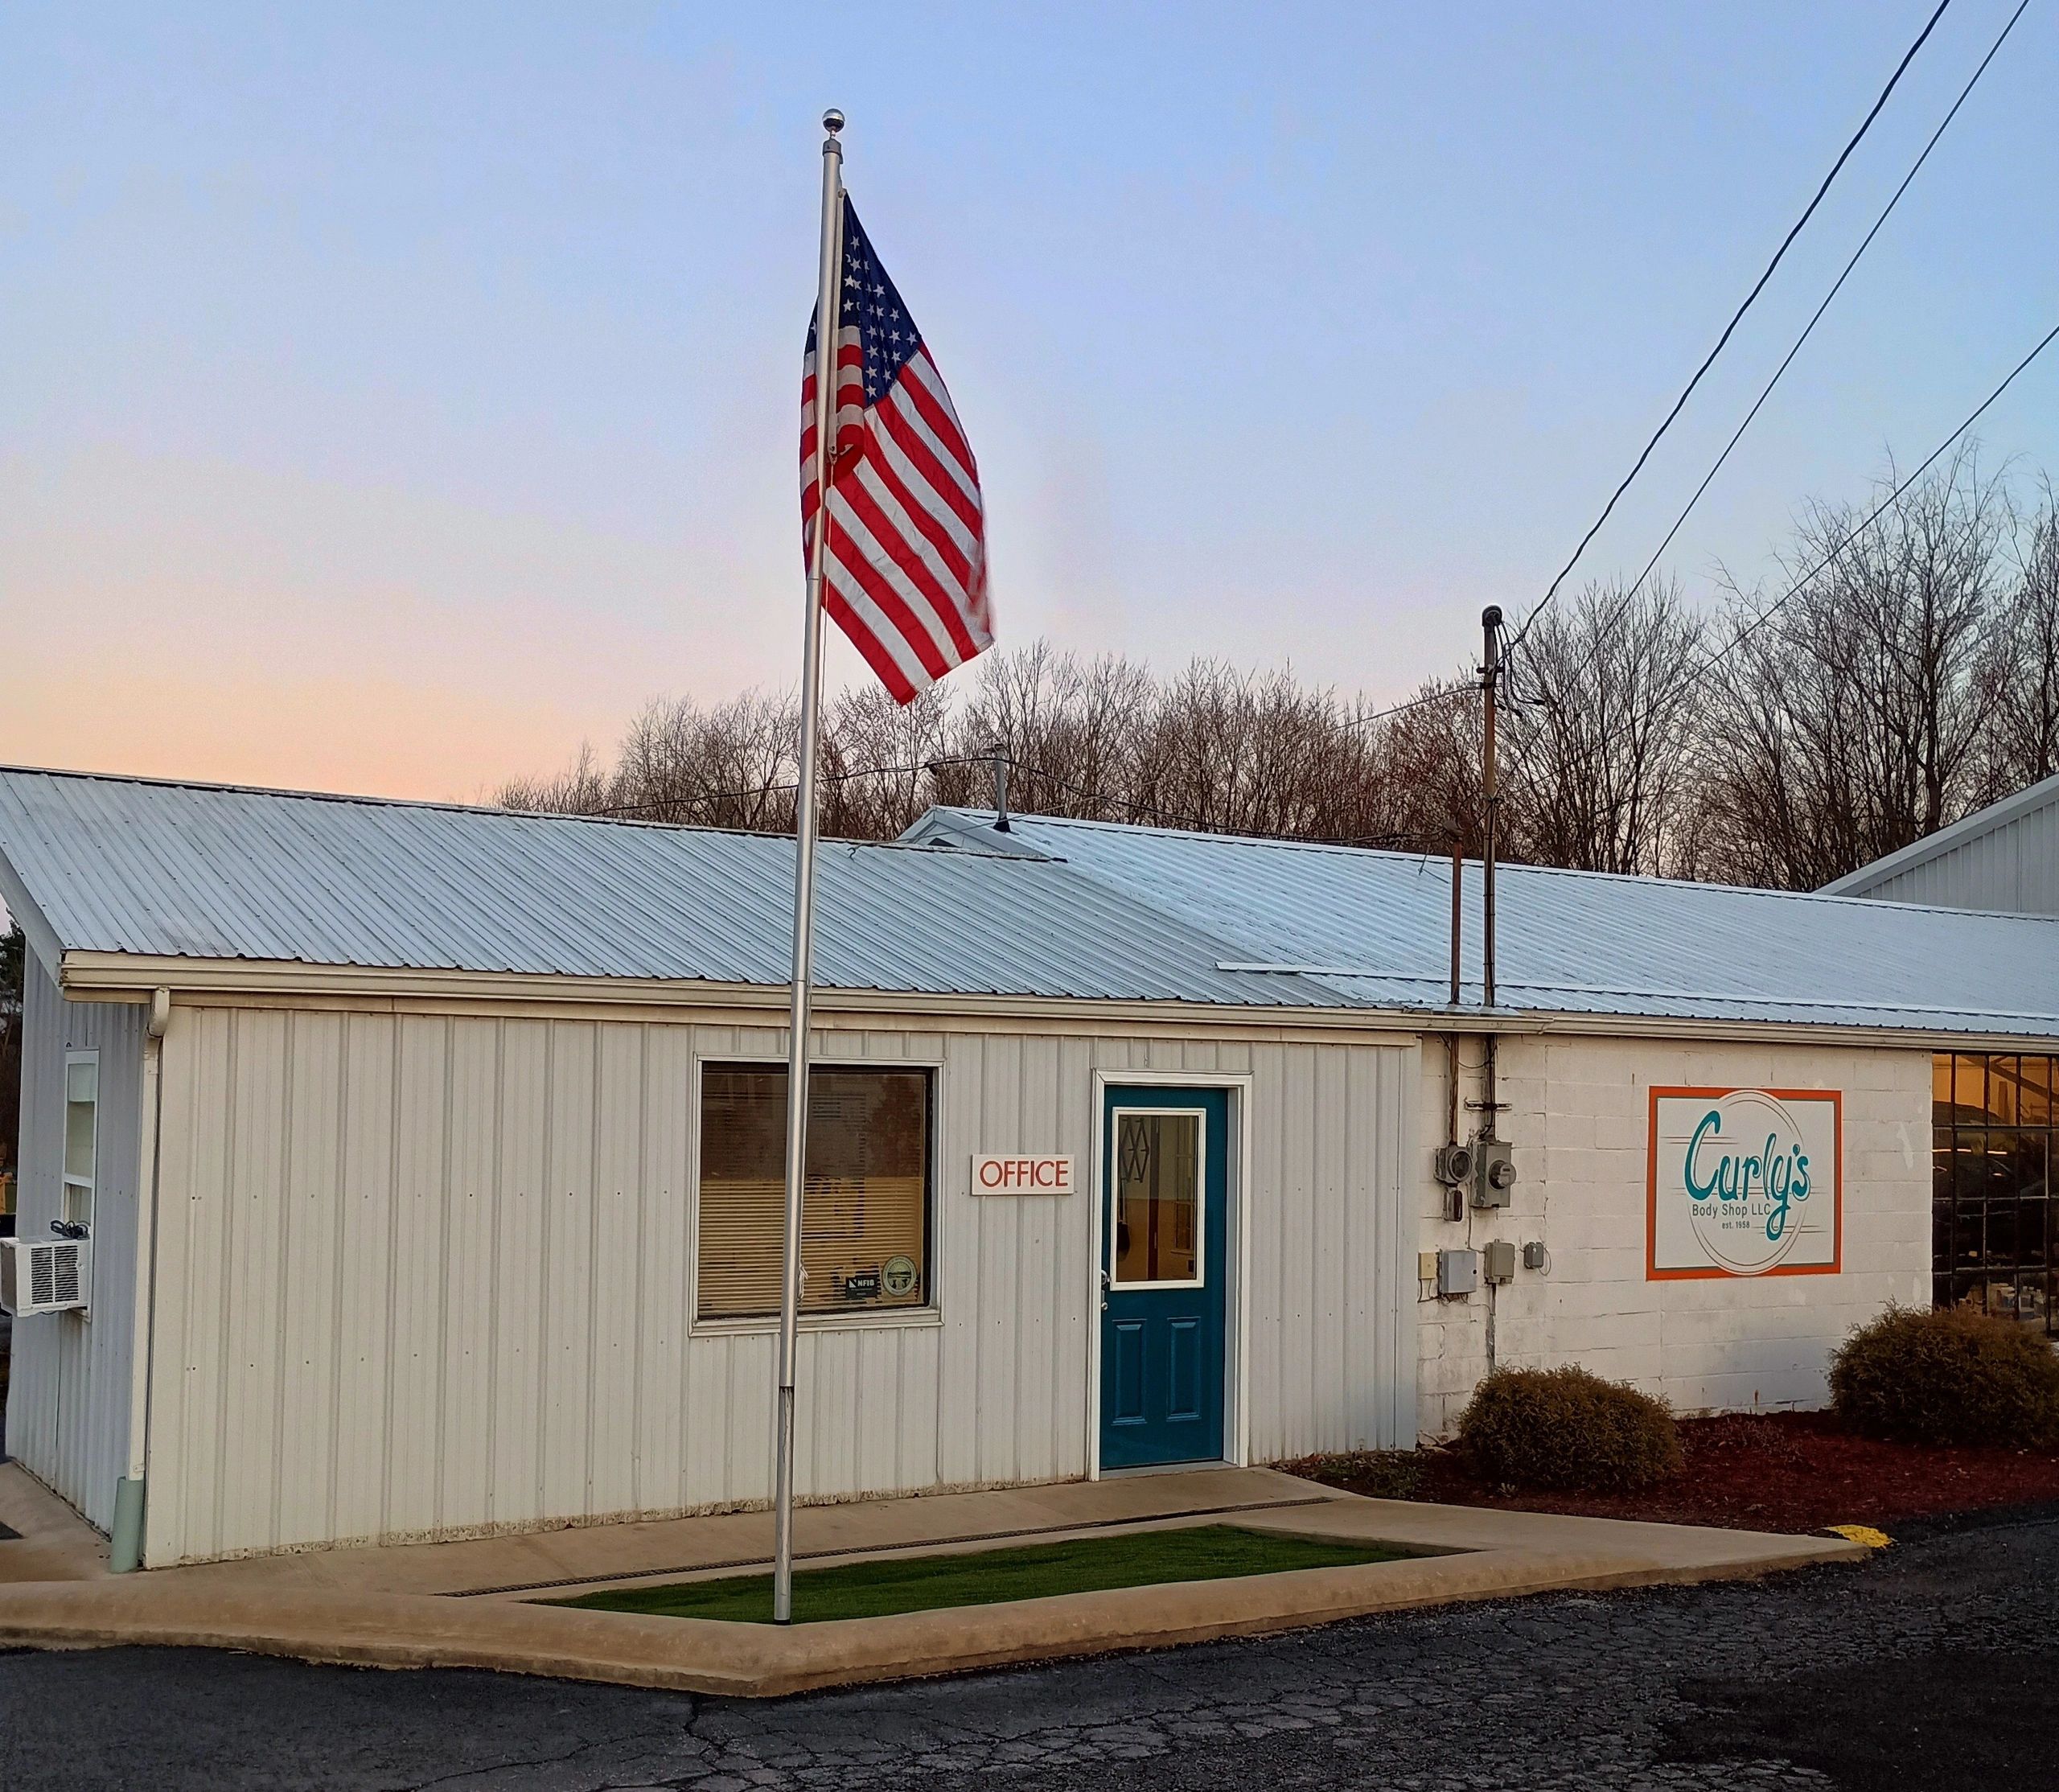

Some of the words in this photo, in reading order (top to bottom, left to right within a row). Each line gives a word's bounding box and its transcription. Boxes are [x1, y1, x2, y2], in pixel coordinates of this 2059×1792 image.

[980, 1161, 1068, 1188] OFFICE
[1685, 1110, 1810, 1240] Curly's
[1692, 1203, 1718, 1219] Body
[1722, 1203, 1748, 1219] Shop
[1751, 1203, 1771, 1215] LLC
[1736, 1221, 1750, 1229] 1958
